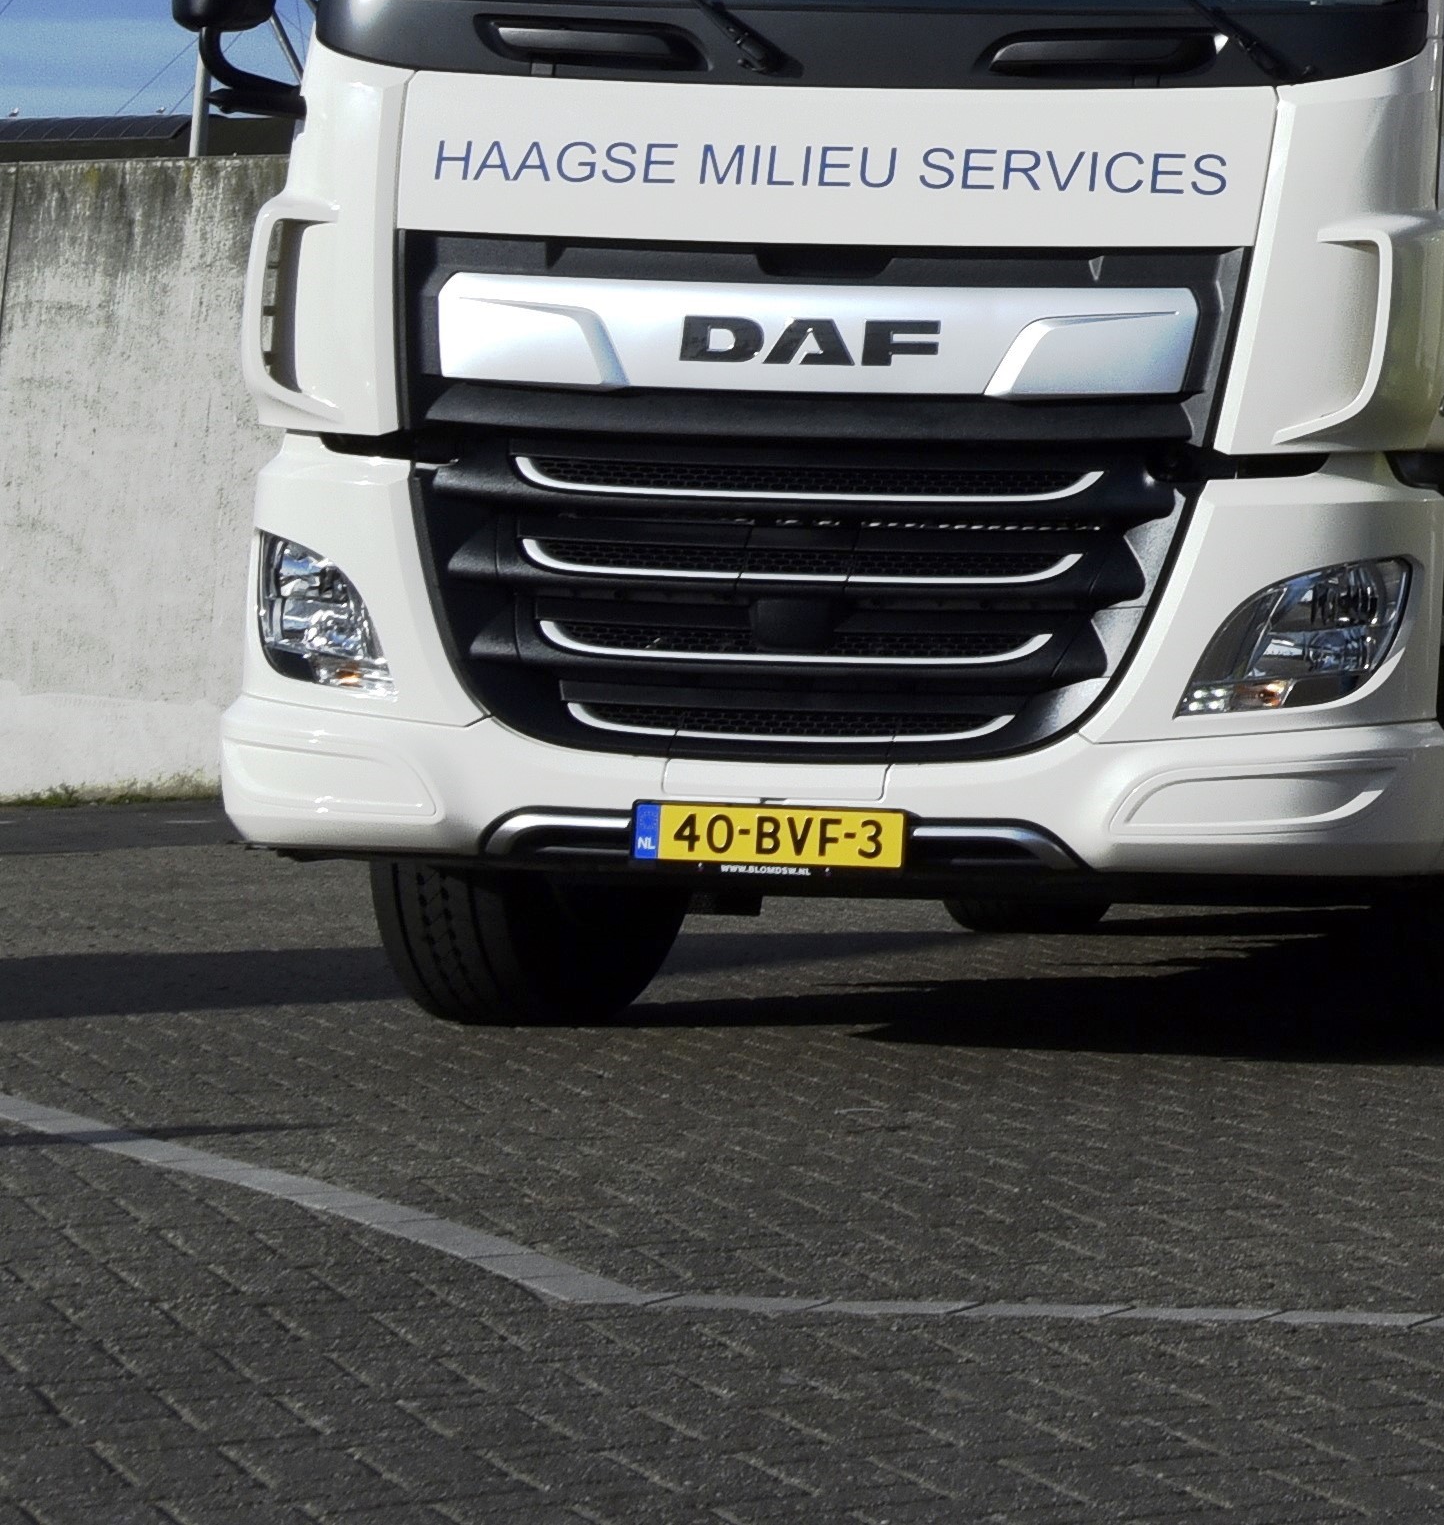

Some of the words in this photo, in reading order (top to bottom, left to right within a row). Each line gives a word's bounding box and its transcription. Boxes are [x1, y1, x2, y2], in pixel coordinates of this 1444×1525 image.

[434, 140, 679, 185] HAAGSE
[699, 143, 898, 189] MILIEU
[919, 147, 1227, 196] SERVICES
[678, 315, 942, 367] DAF
[636, 836, 656, 850] NL
[673, 812, 883, 860] 40-BVF-3
